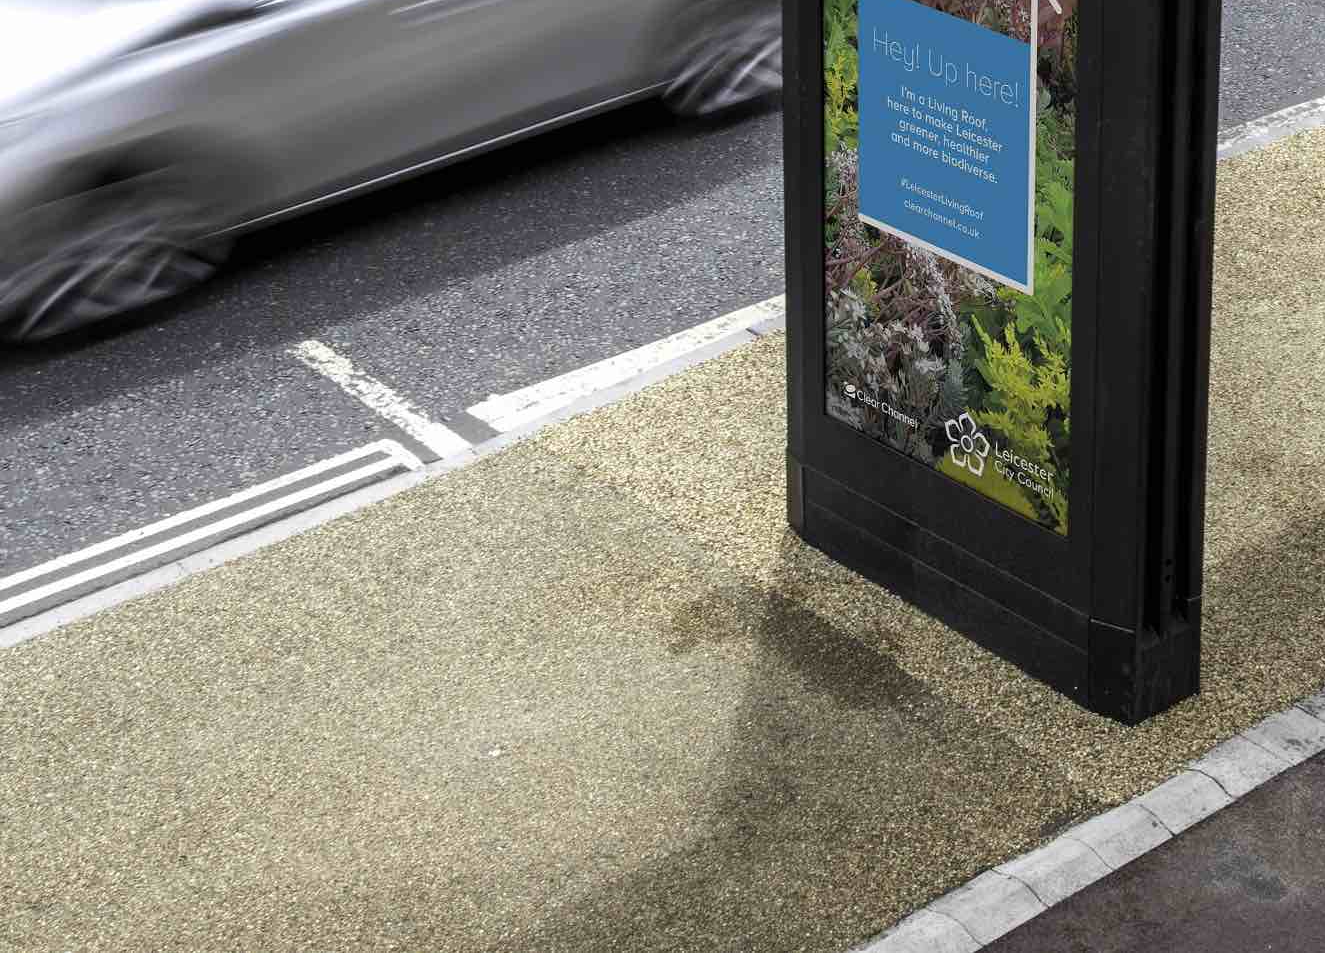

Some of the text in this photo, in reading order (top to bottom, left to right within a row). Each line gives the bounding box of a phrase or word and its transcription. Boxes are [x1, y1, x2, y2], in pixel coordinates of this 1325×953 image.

[873, 26, 1019, 108] Hey! Up here!
[887, 96, 1003, 152] here to make Leicester
[901, 86, 988, 132] I'm a Living Roof,
[891, 131, 998, 184] and more biodiverse.
[899, 119, 990, 163] greener, healthier
[903, 198, 980, 239] clearchannel.co.uk
[857, 390, 918, 429] Clear Channel
[994, 460, 1054, 502] City Council
[995, 441, 1055, 482] Leicester
